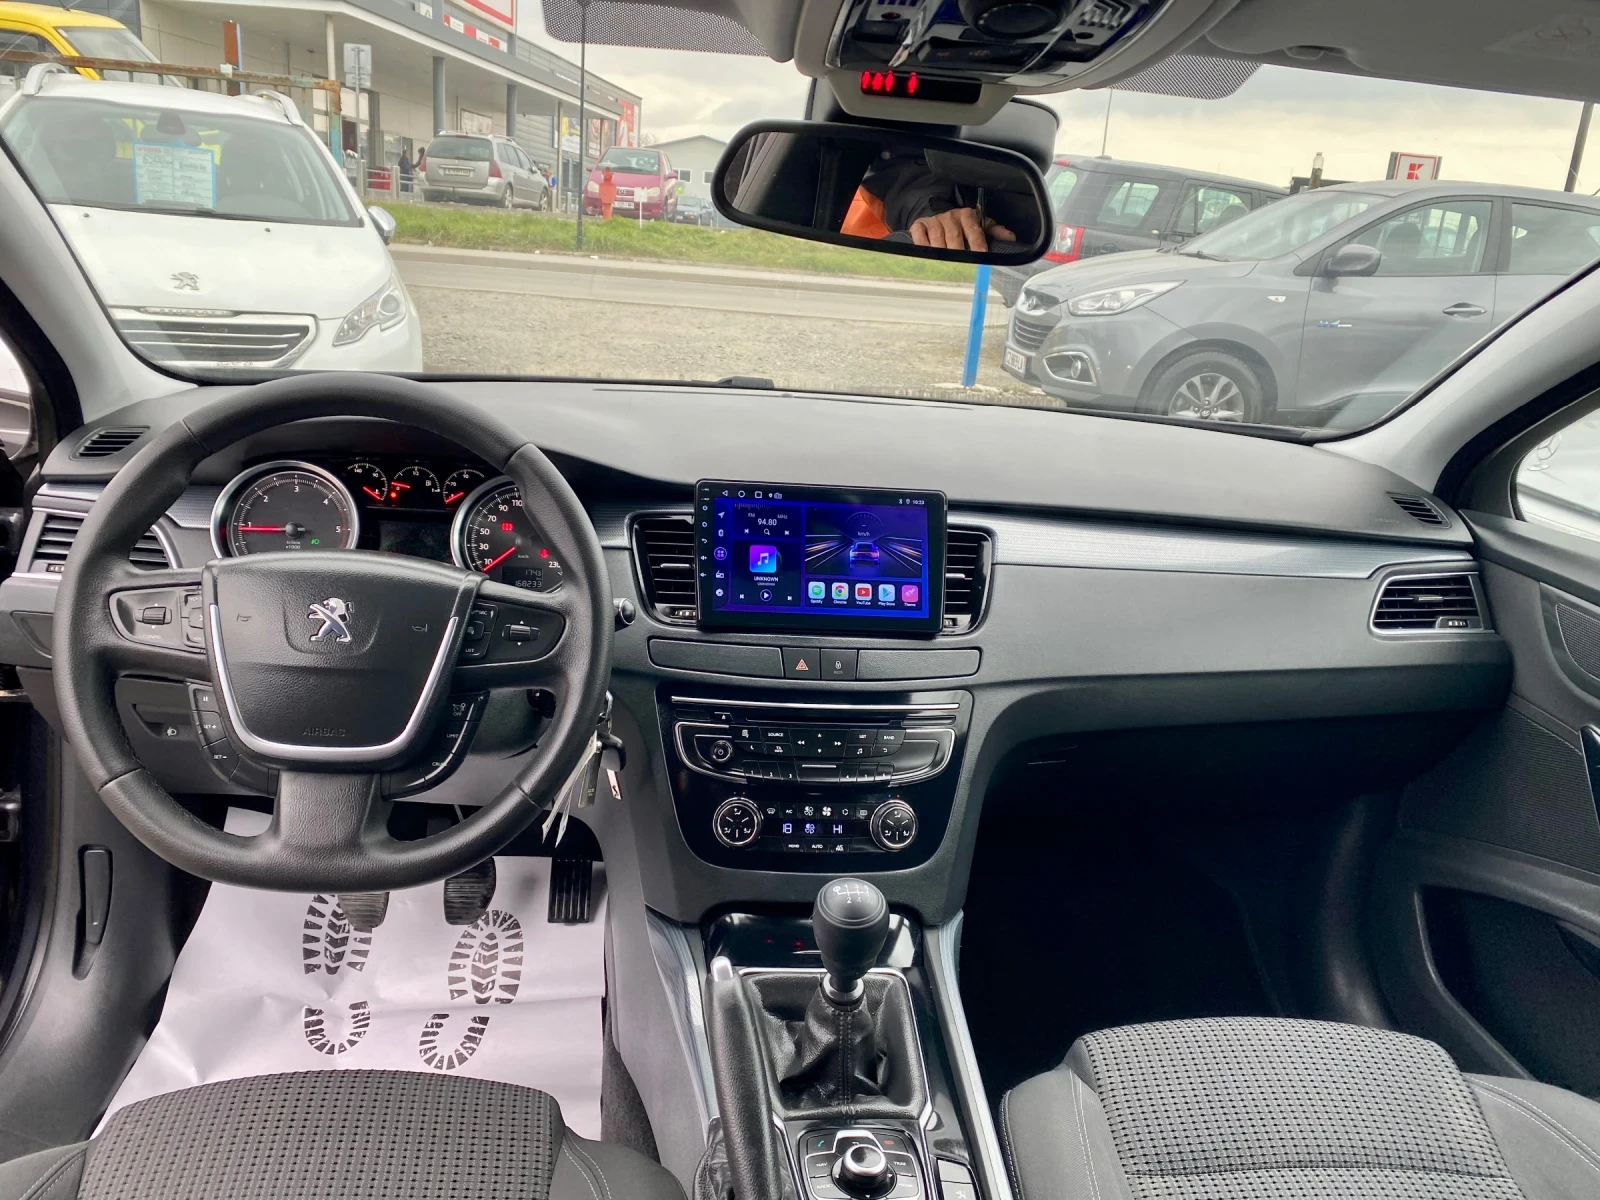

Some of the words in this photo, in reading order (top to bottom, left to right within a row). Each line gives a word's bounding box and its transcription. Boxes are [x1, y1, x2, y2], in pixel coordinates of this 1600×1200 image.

[302, 728, 346, 736] AIRBAG
[782, 823, 792, 834] 18
[832, 824, 842, 834] HI
